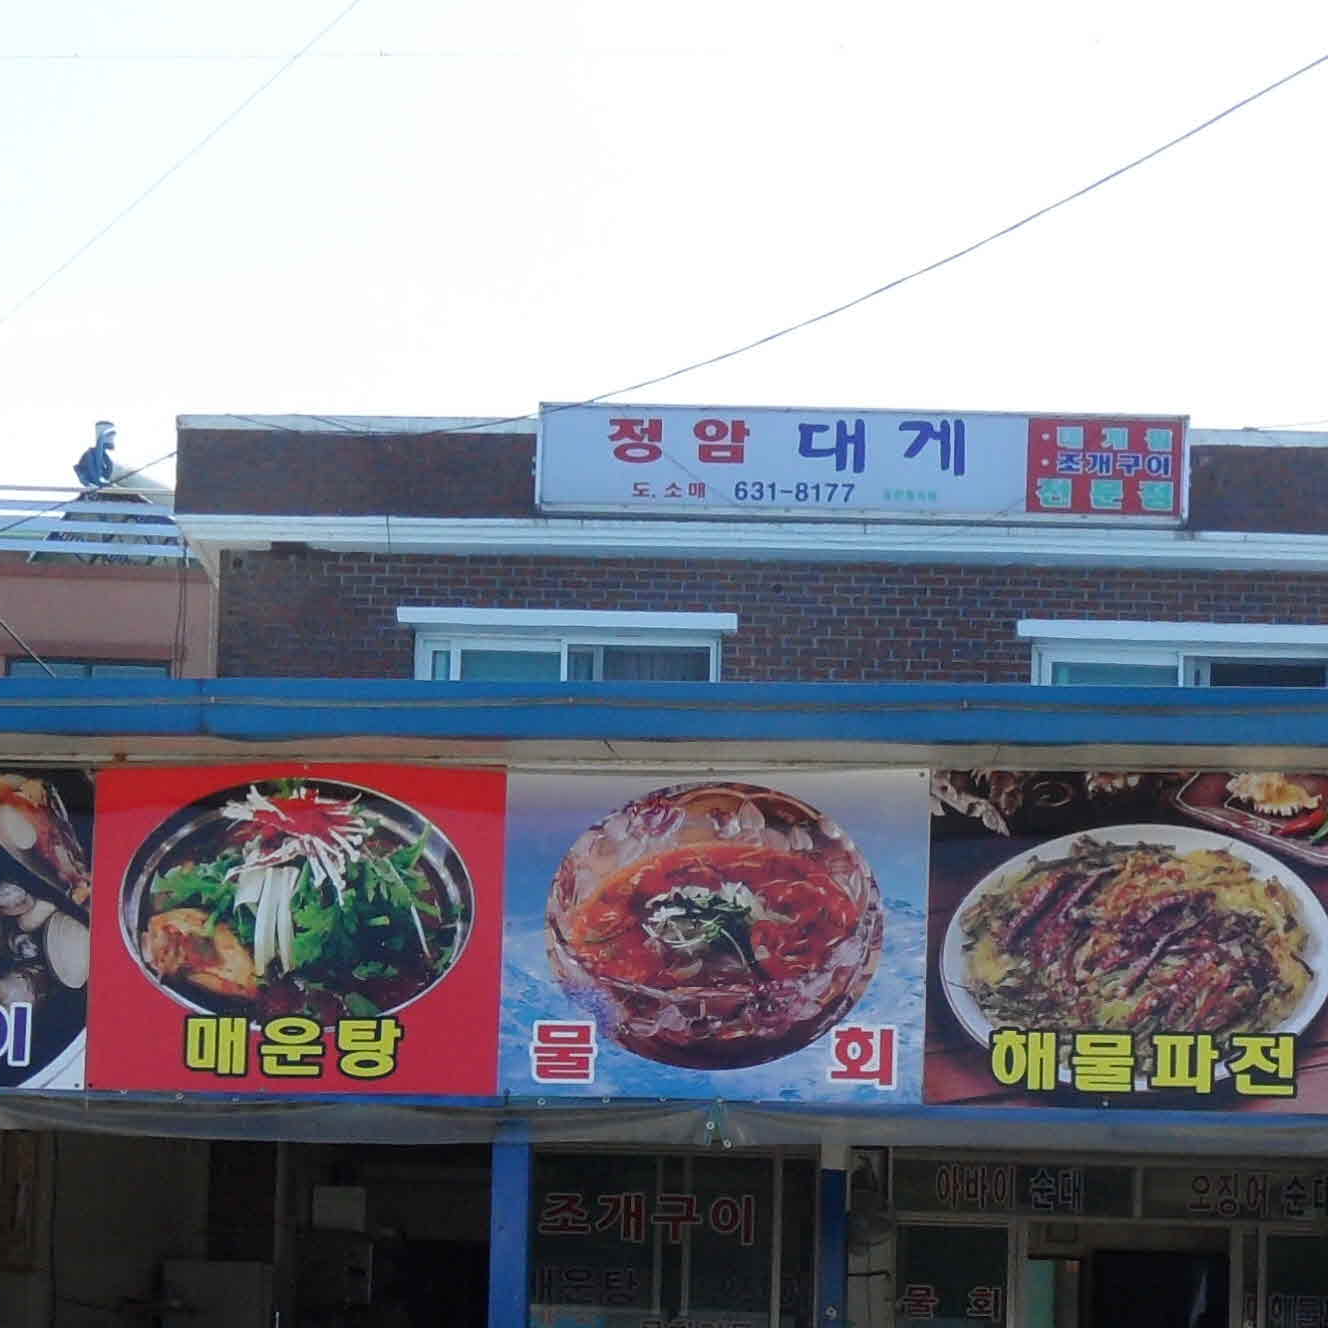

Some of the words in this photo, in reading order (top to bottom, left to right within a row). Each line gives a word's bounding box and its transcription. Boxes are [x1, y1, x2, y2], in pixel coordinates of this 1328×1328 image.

[608, 418, 750, 464] 정암
[799, 418, 966, 475] 대게
[1056, 451, 1172, 477] 조개구이
[734, 480, 856, 503] 631-8177
[184, 1015, 404, 1079] 매운탕
[989, 1028, 1299, 1099] 해물파전
[538, 1192, 756, 1247] 조개구이
